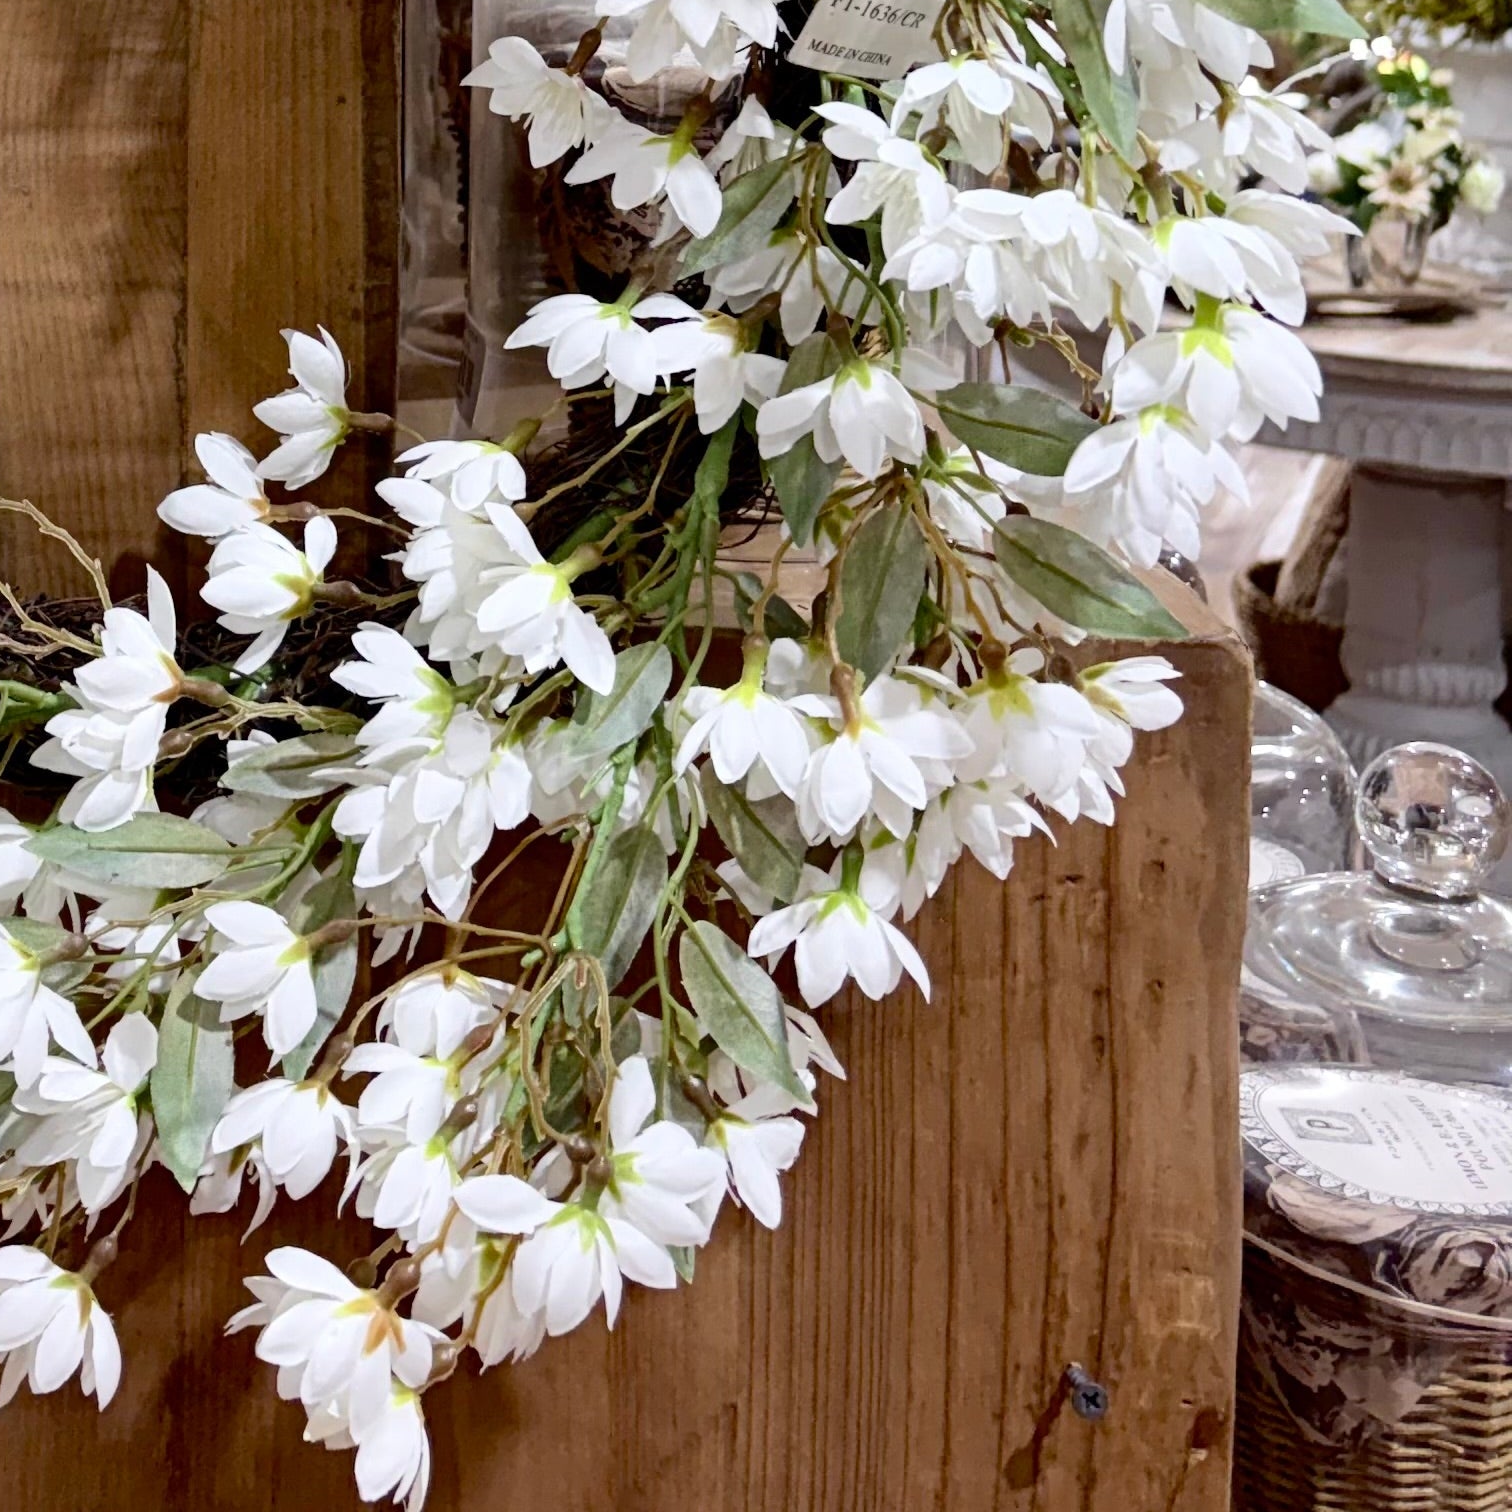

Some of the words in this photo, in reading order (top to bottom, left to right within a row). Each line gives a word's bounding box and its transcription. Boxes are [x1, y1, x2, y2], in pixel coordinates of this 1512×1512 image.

[807, 39, 844, 57] MADE
[844, 48, 859, 60] IN
[859, 51, 892, 66] CHINA
